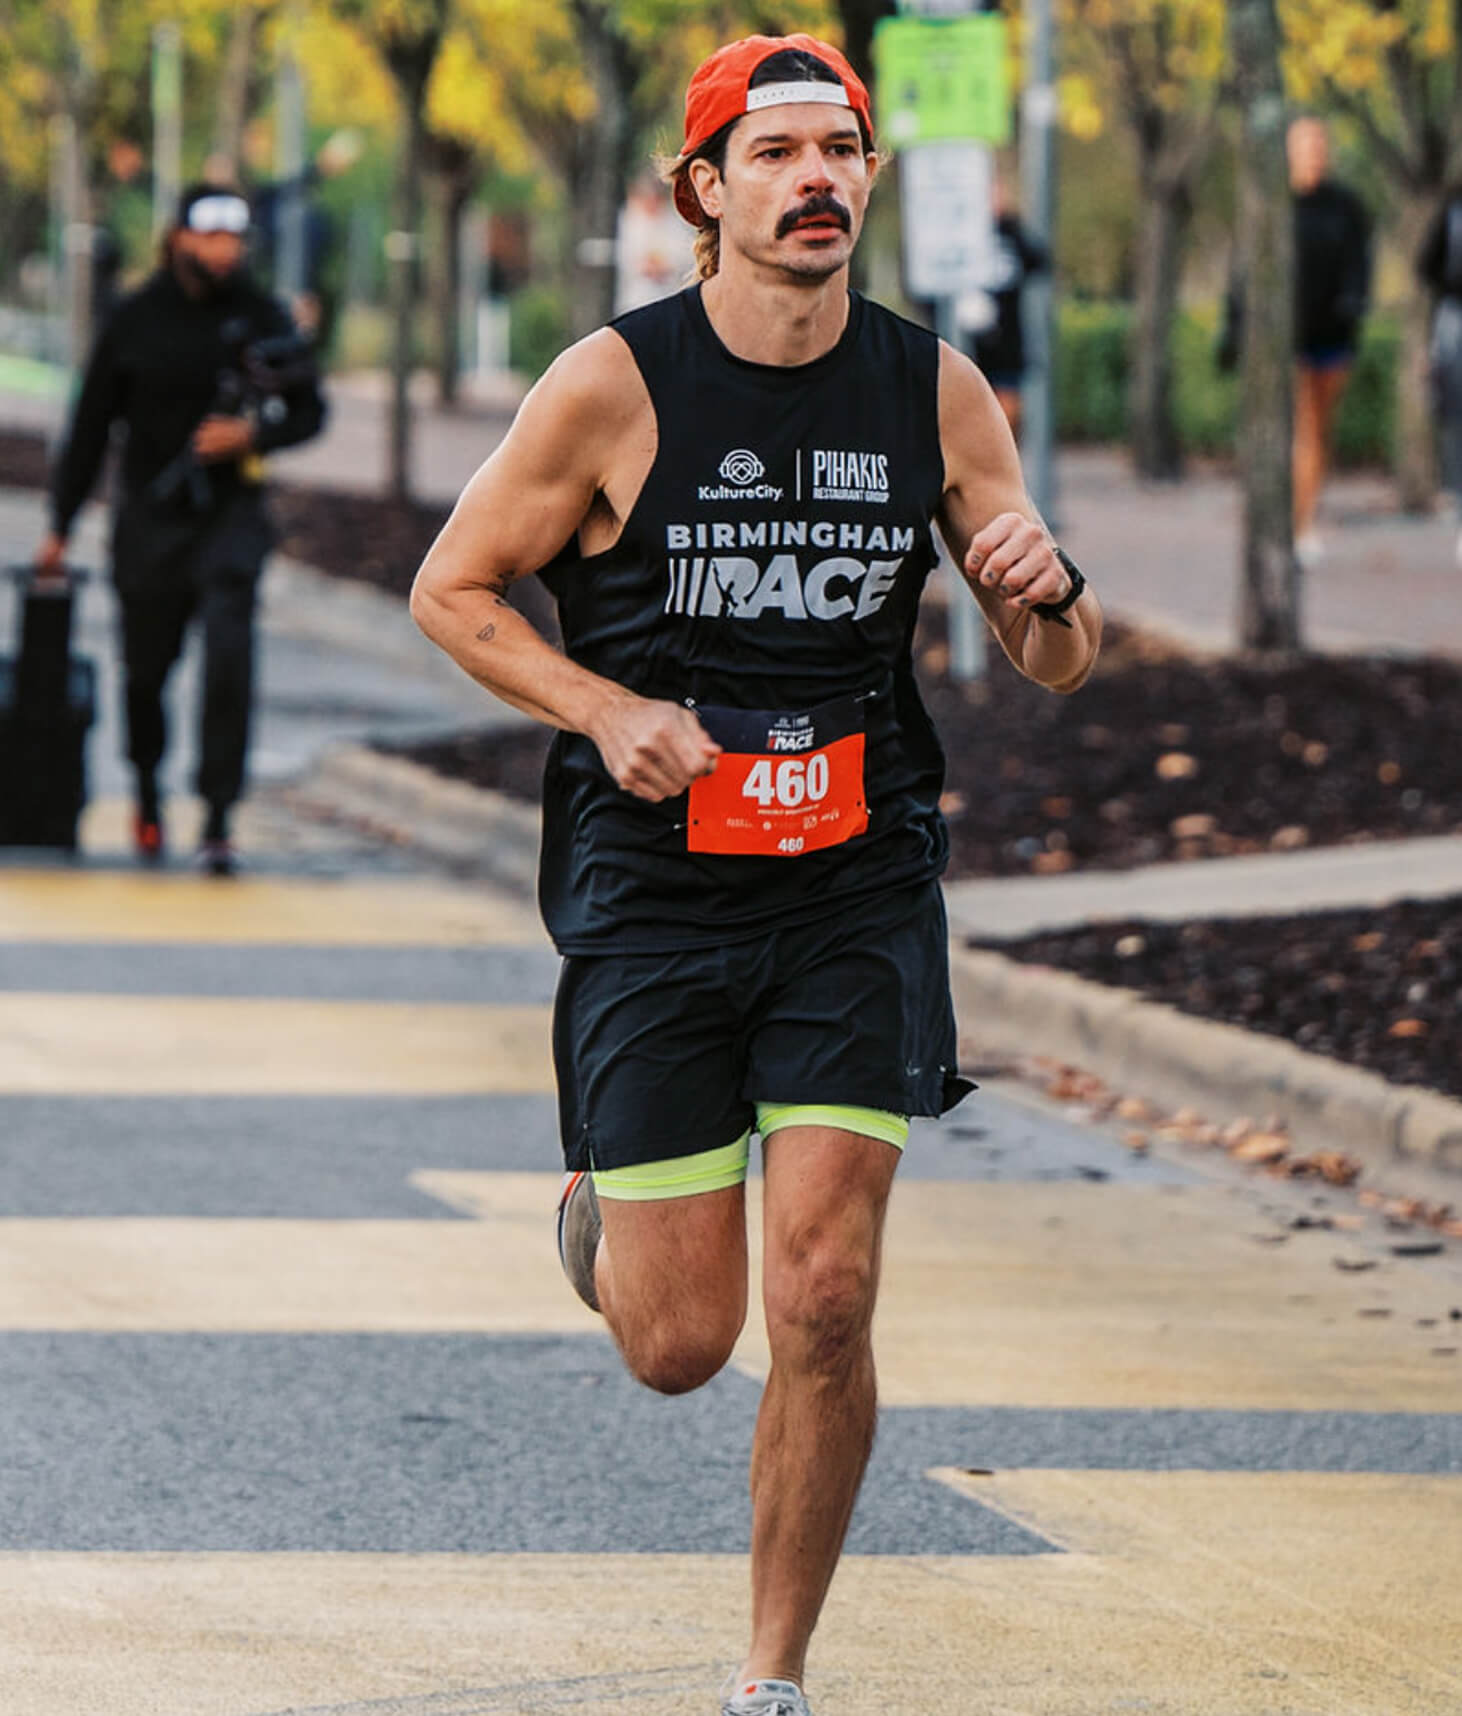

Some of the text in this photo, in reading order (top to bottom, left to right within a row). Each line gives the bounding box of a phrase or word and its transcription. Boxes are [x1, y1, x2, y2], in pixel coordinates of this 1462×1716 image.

[813, 450, 889, 490] PIHAKIS
[698, 484, 783, 502] KultureCity
[667, 521, 915, 551] BIRMINGHAM
[699, 554, 904, 621] RACE
[742, 754, 829, 807] 460
[777, 836, 804, 853] 460
